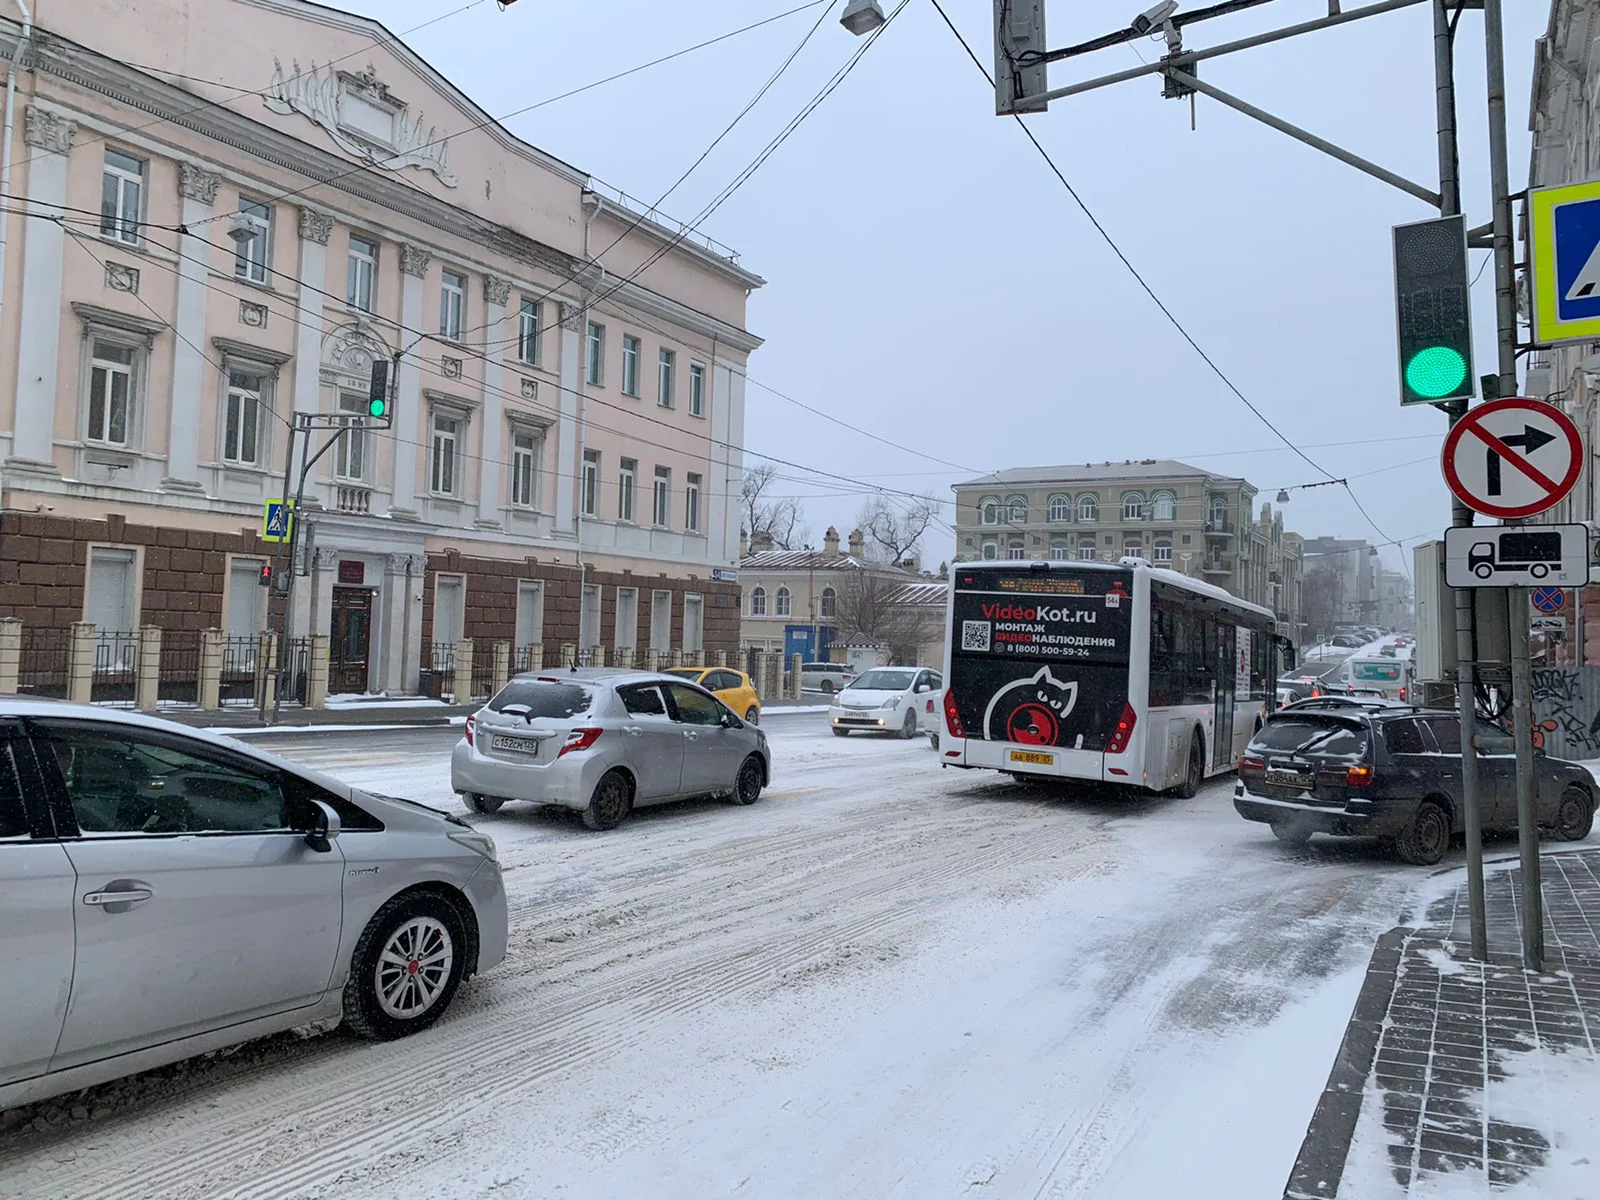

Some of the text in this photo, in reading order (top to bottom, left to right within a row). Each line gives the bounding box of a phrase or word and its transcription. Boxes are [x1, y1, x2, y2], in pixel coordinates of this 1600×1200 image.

[981, 603, 1097, 624] VideoKot.ru
[995, 623, 1046, 633] МОНТАЖ
[995, 633, 1116, 647] ВИДЕОНАБЛЮДЕНИЯ
[1007, 644, 1090, 657] 8 (800) 500-59-24
